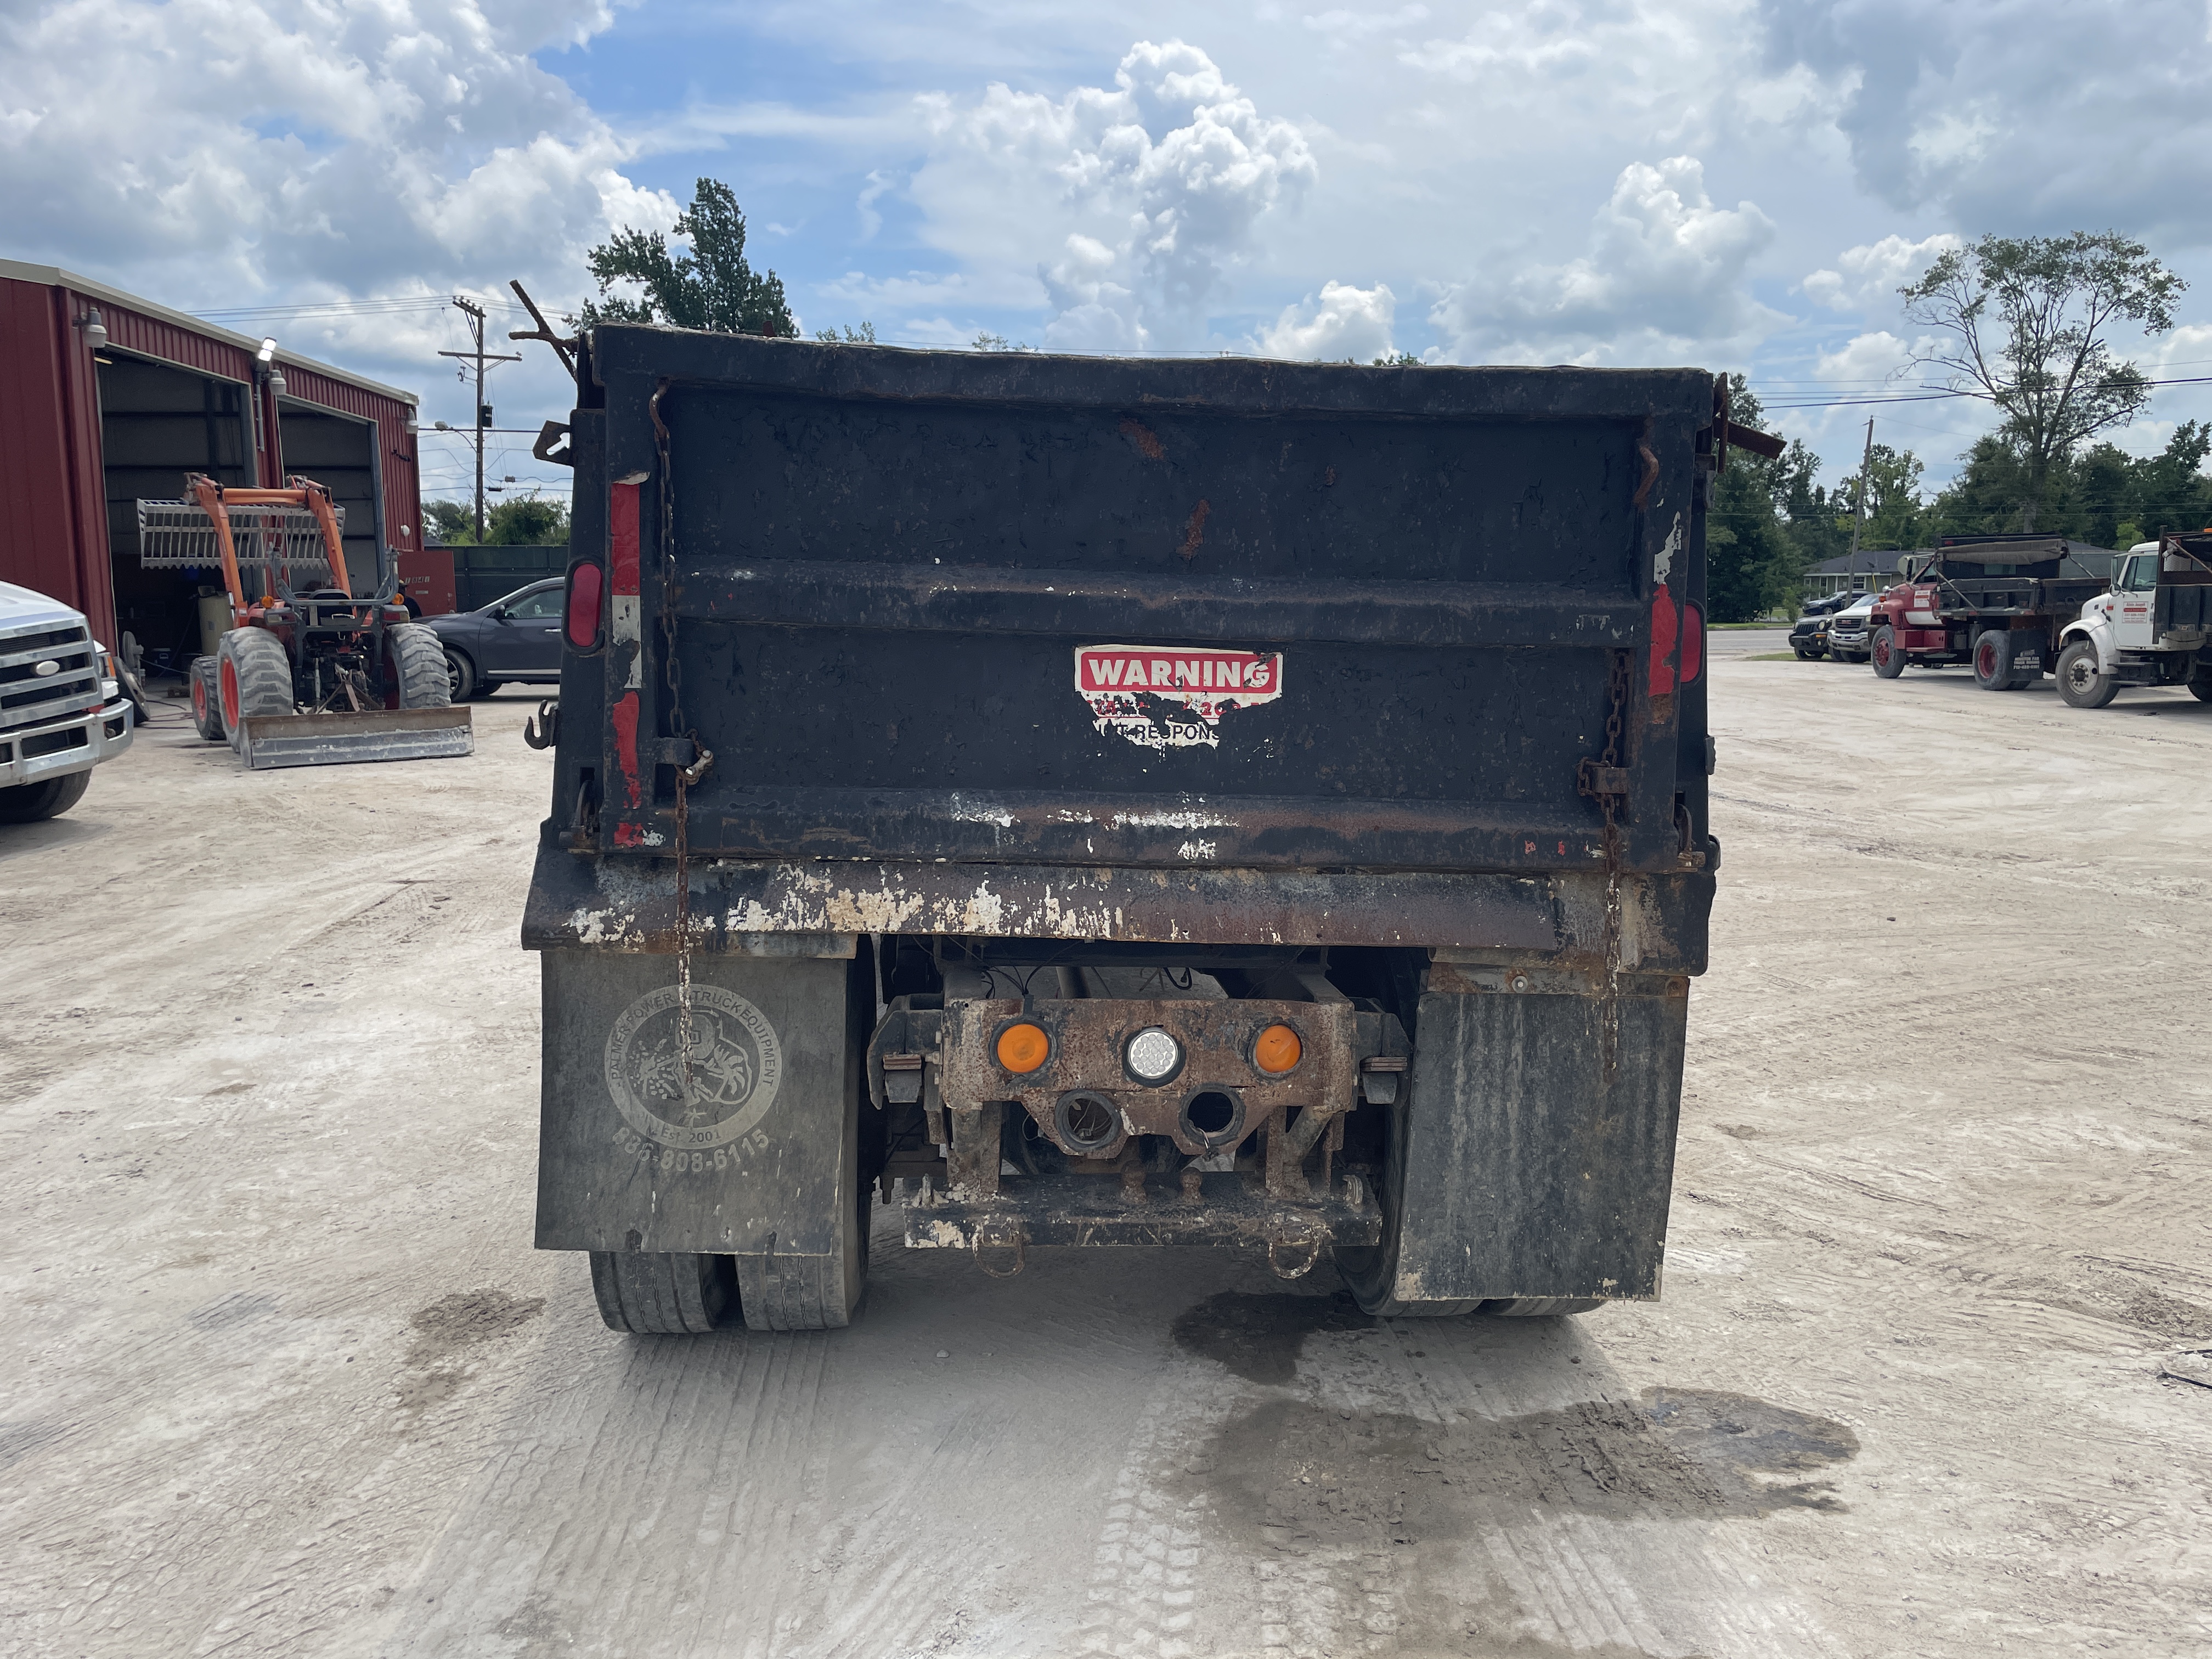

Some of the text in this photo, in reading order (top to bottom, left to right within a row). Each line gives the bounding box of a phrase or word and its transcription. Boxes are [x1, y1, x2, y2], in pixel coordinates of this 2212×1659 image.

[1088, 659, 1270, 688] WARNING
[610, 990, 776, 1087] PALMER POWER TRUCK EQUIPMENT
[688, 1131, 722, 1143] 2001
